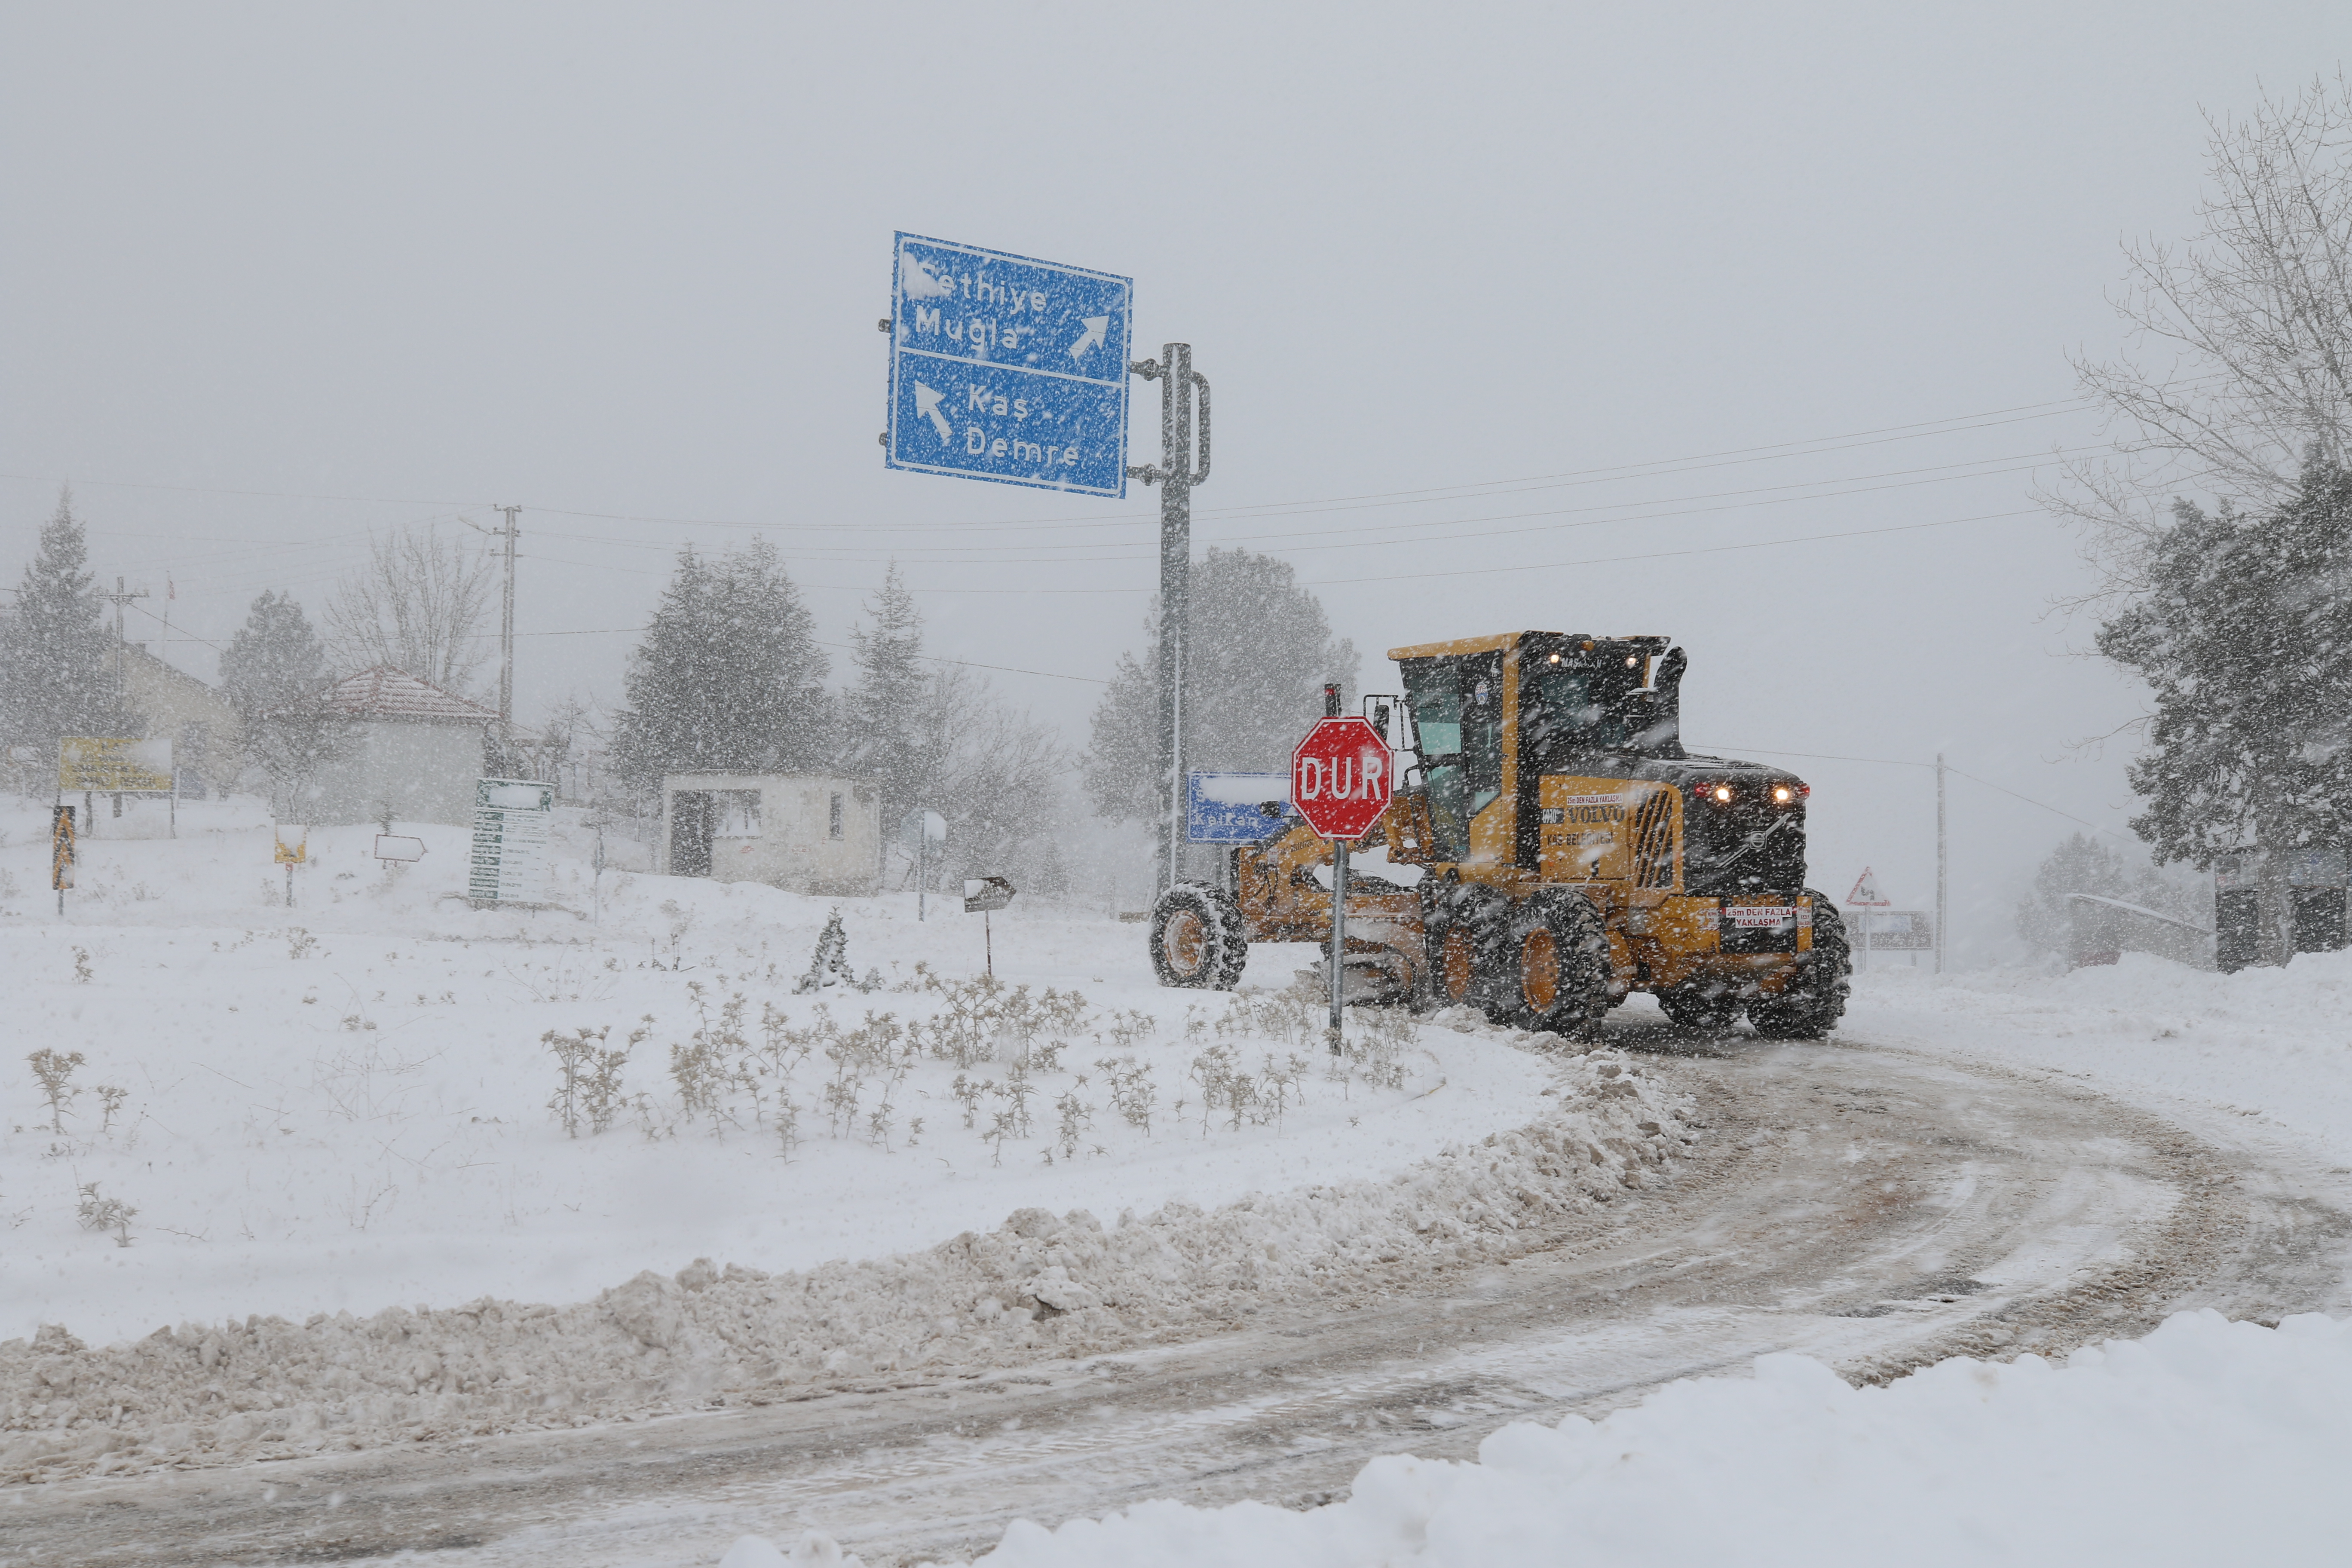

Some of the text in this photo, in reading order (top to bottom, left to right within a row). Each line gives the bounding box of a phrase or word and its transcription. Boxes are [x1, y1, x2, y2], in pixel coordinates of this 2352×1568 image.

[916, 305, 1017, 350] Muğla
[969, 383, 1029, 422] Kaş
[967, 427, 1079, 466] Demre
[1301, 756, 1382, 799] DUR
[1194, 812, 1258, 826] Kalkan
[1567, 805, 1625, 823] VOLVO
[1736, 918, 1781, 927] YAKLAŞMA
